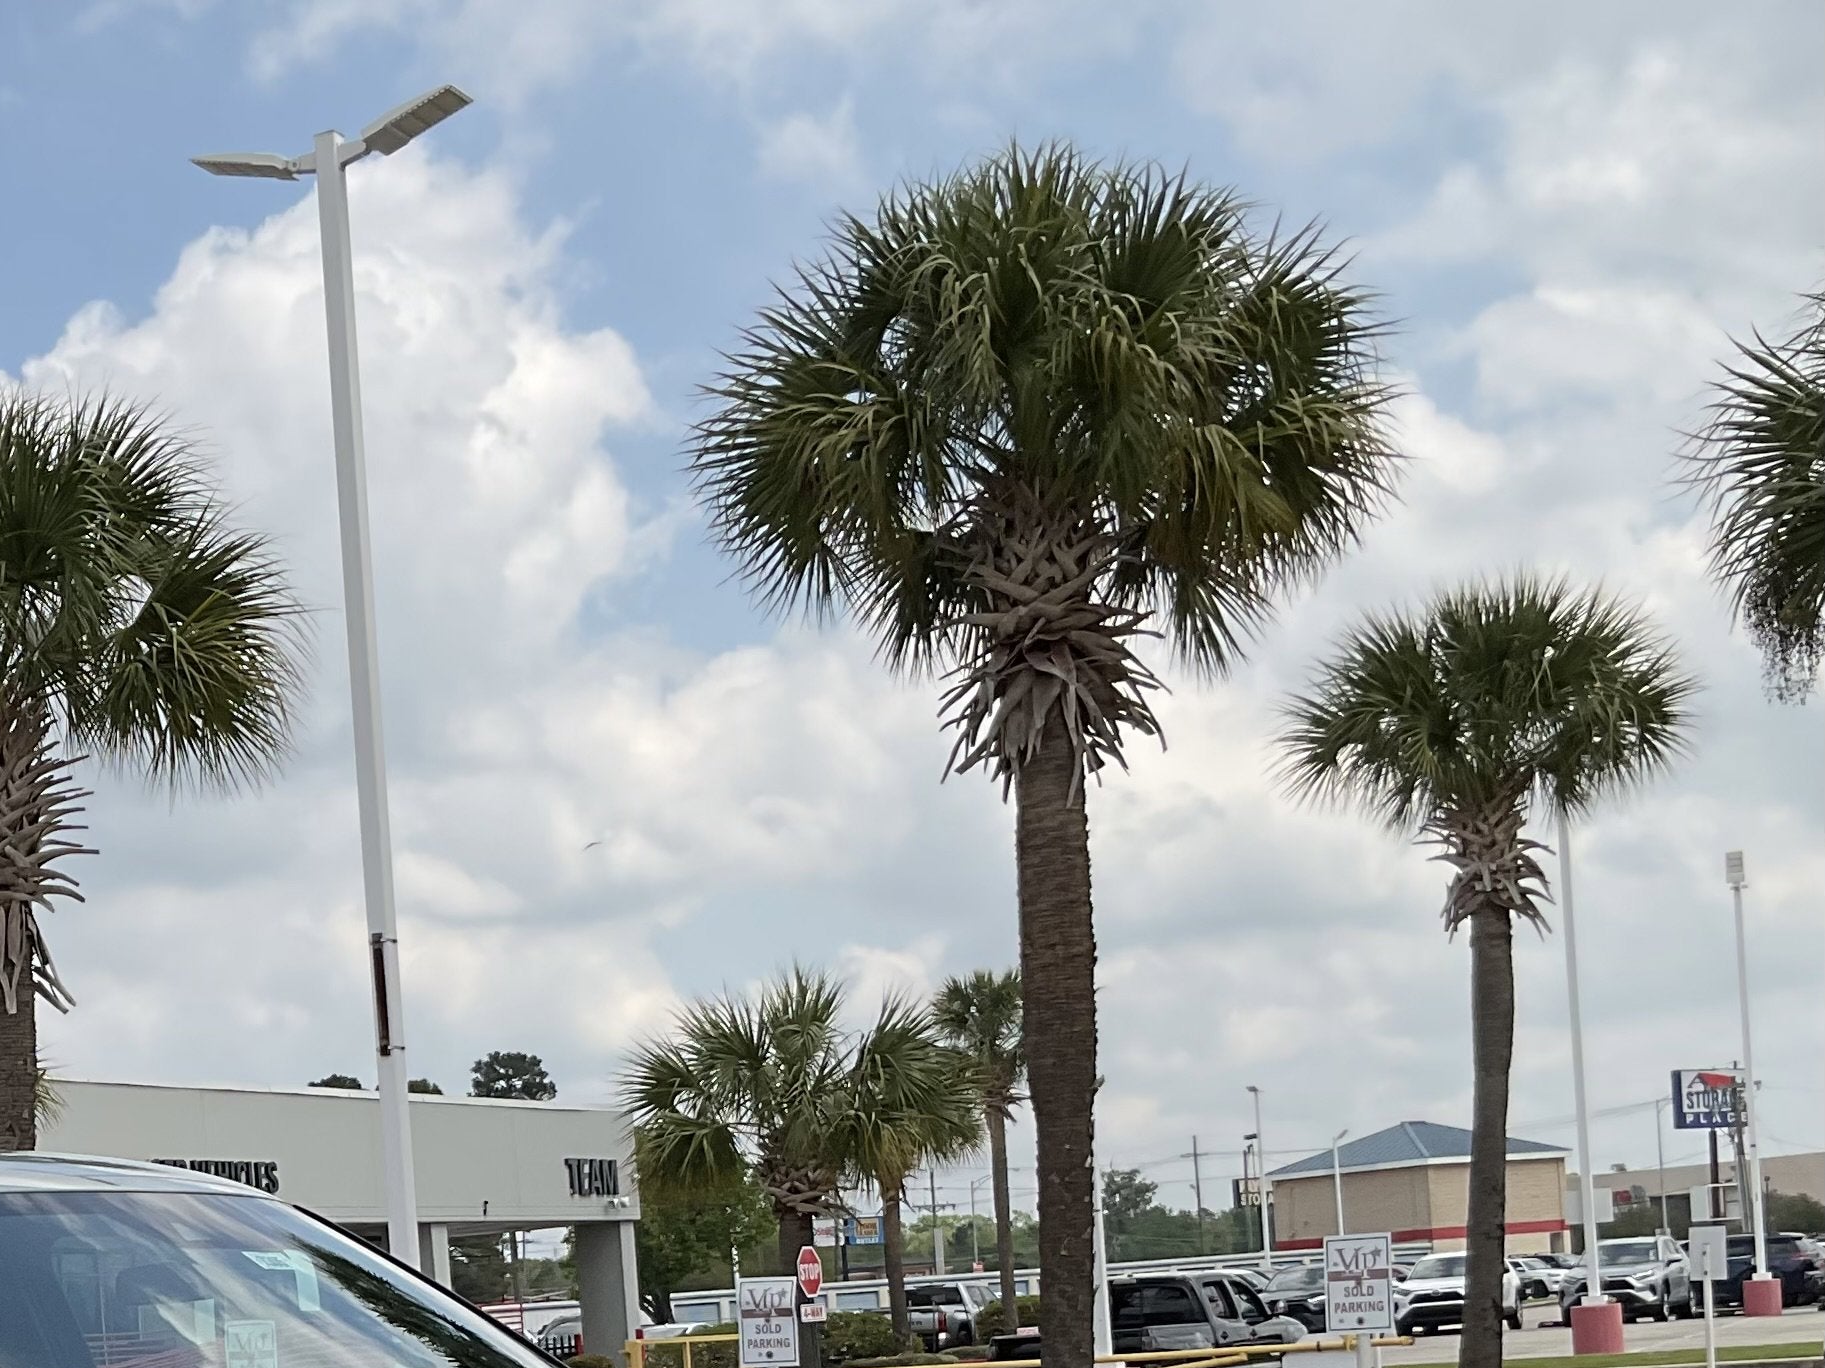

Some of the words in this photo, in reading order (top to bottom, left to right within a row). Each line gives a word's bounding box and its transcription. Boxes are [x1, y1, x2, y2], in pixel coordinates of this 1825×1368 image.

[564, 1158, 619, 1197] TEAM
[799, 1263, 820, 1281] STOP
[1344, 1285, 1374, 1297] SOLD
[803, 1306, 823, 1318] 4-WAY
[1335, 1301, 1384, 1314] PARKING
[755, 1323, 782, 1335] SOLD
[747, 1338, 791, 1349] PARKING
